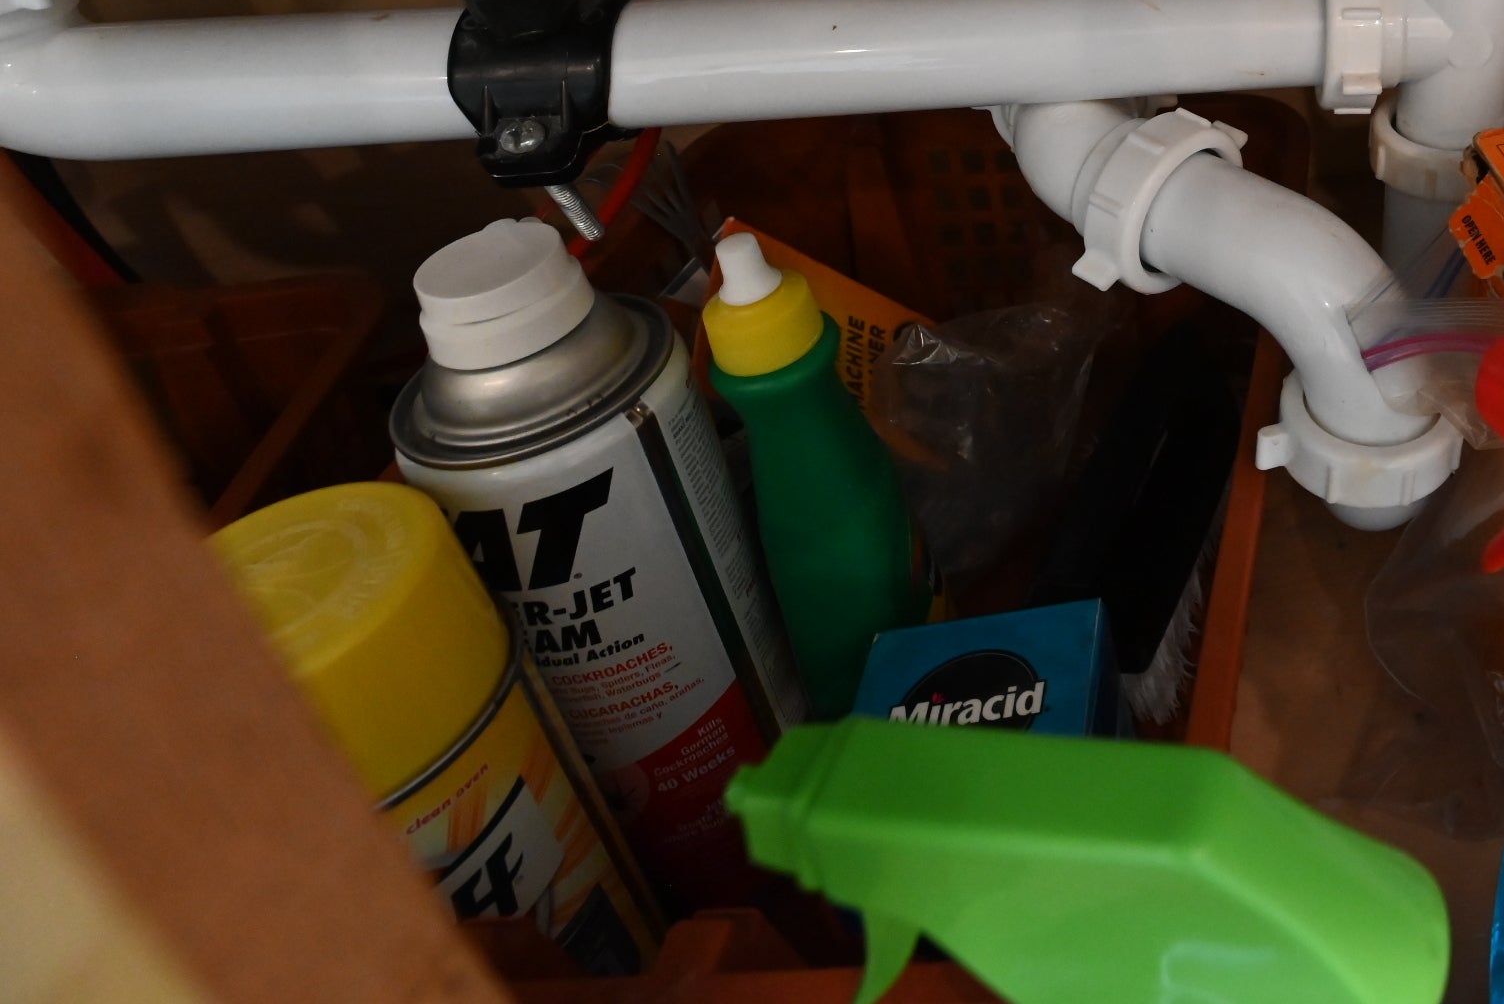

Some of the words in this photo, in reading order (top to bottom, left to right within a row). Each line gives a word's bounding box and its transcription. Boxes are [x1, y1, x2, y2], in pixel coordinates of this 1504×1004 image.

[1461, 215, 1482, 241] OPEN
[1475, 239, 1496, 265] HERE
[454, 466, 614, 592] AT
[551, 641, 674, 687] COCKROACHES,
[586, 633, 646, 664] Action
[644, 654, 677, 674] Fleas,
[567, 680, 680, 720] CUCARACHAS,
[888, 680, 1046, 726] Miracid
[679, 723, 728, 757] German
[696, 716, 724, 738] Kills
[653, 731, 730, 777] Cockroaches
[656, 777, 680, 793] 40
[680, 744, 738, 784] Weeks
[405, 797, 452, 836] clean
[455, 762, 490, 799] oven
